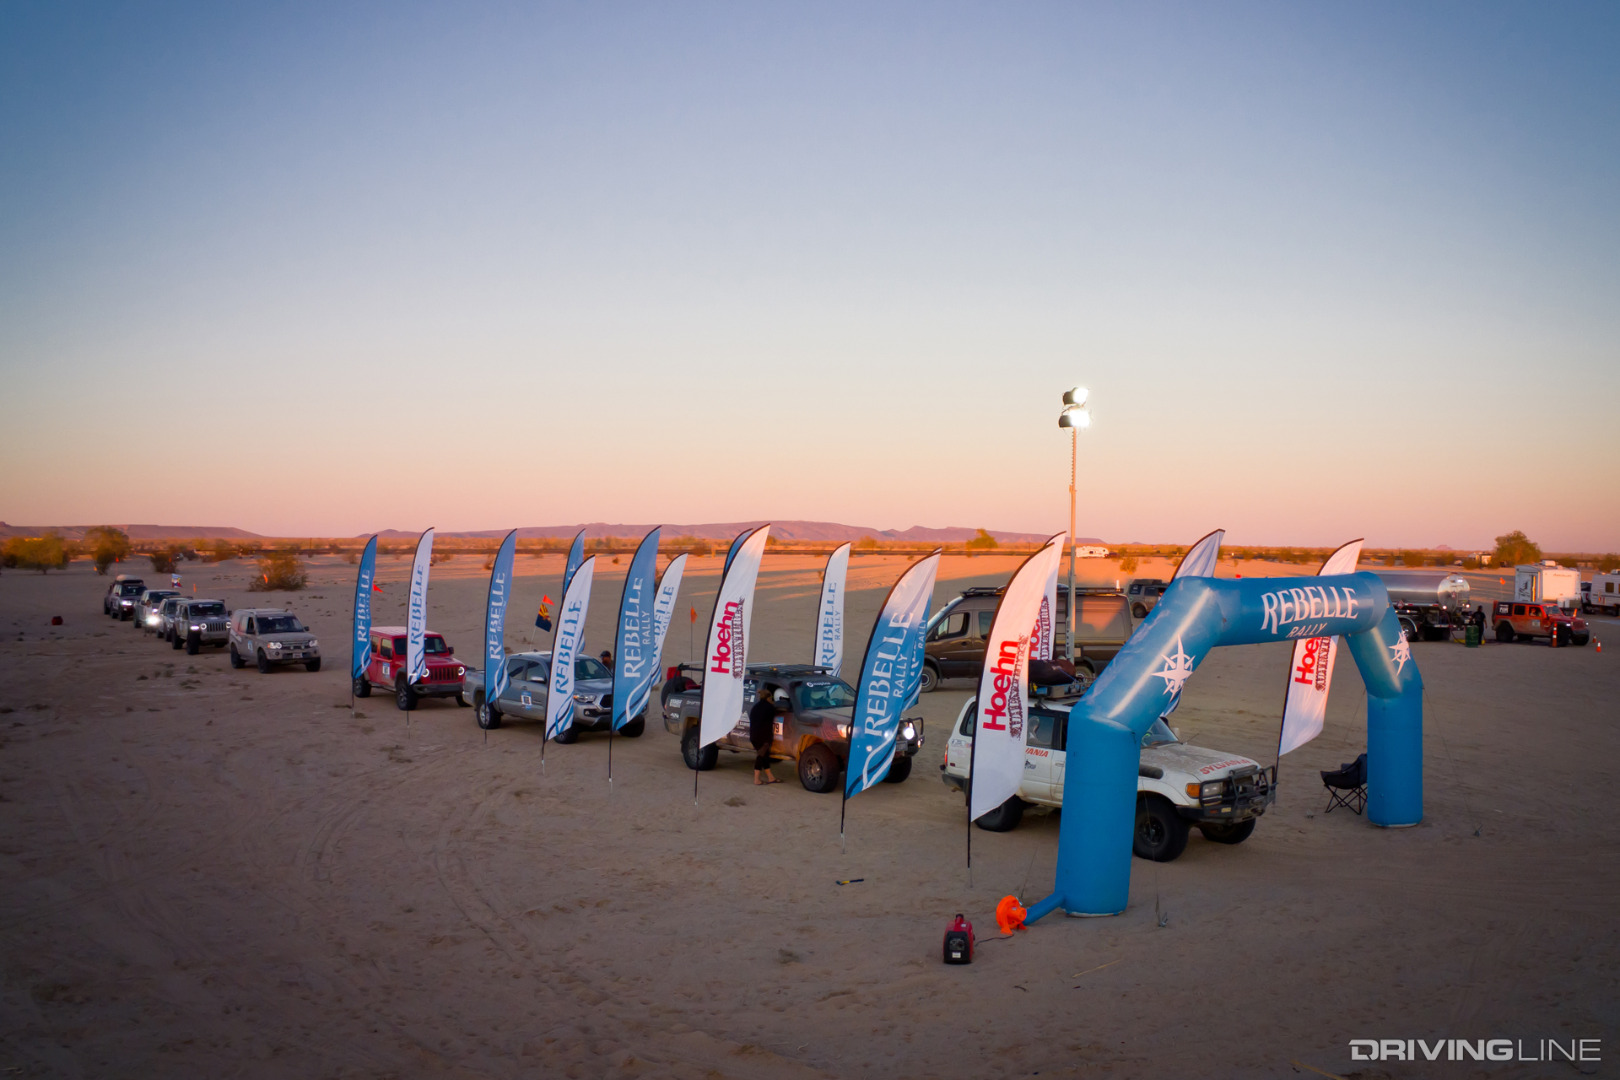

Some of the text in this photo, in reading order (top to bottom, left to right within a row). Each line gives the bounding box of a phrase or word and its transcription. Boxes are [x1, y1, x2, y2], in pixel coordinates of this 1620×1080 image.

[357, 569, 370, 642] REBELLE
[411, 564, 424, 645] REBELLE
[489, 572, 506, 660] REBELLE
[623, 577, 646, 678] REBELLE
[641, 610, 651, 645] RALLY
[711, 601, 739, 674] Hoehn
[821, 582, 837, 667] REBELLE
[917, 618, 927, 649] RALLY
[1260, 586, 1359, 635] REBELLE
[1285, 622, 1328, 638] RALLY
[555, 599, 582, 694] REBELLE
[864, 612, 914, 737] REBELLE
[892, 653, 908, 698] RALLY
[982, 640, 1020, 732] Hoehn
